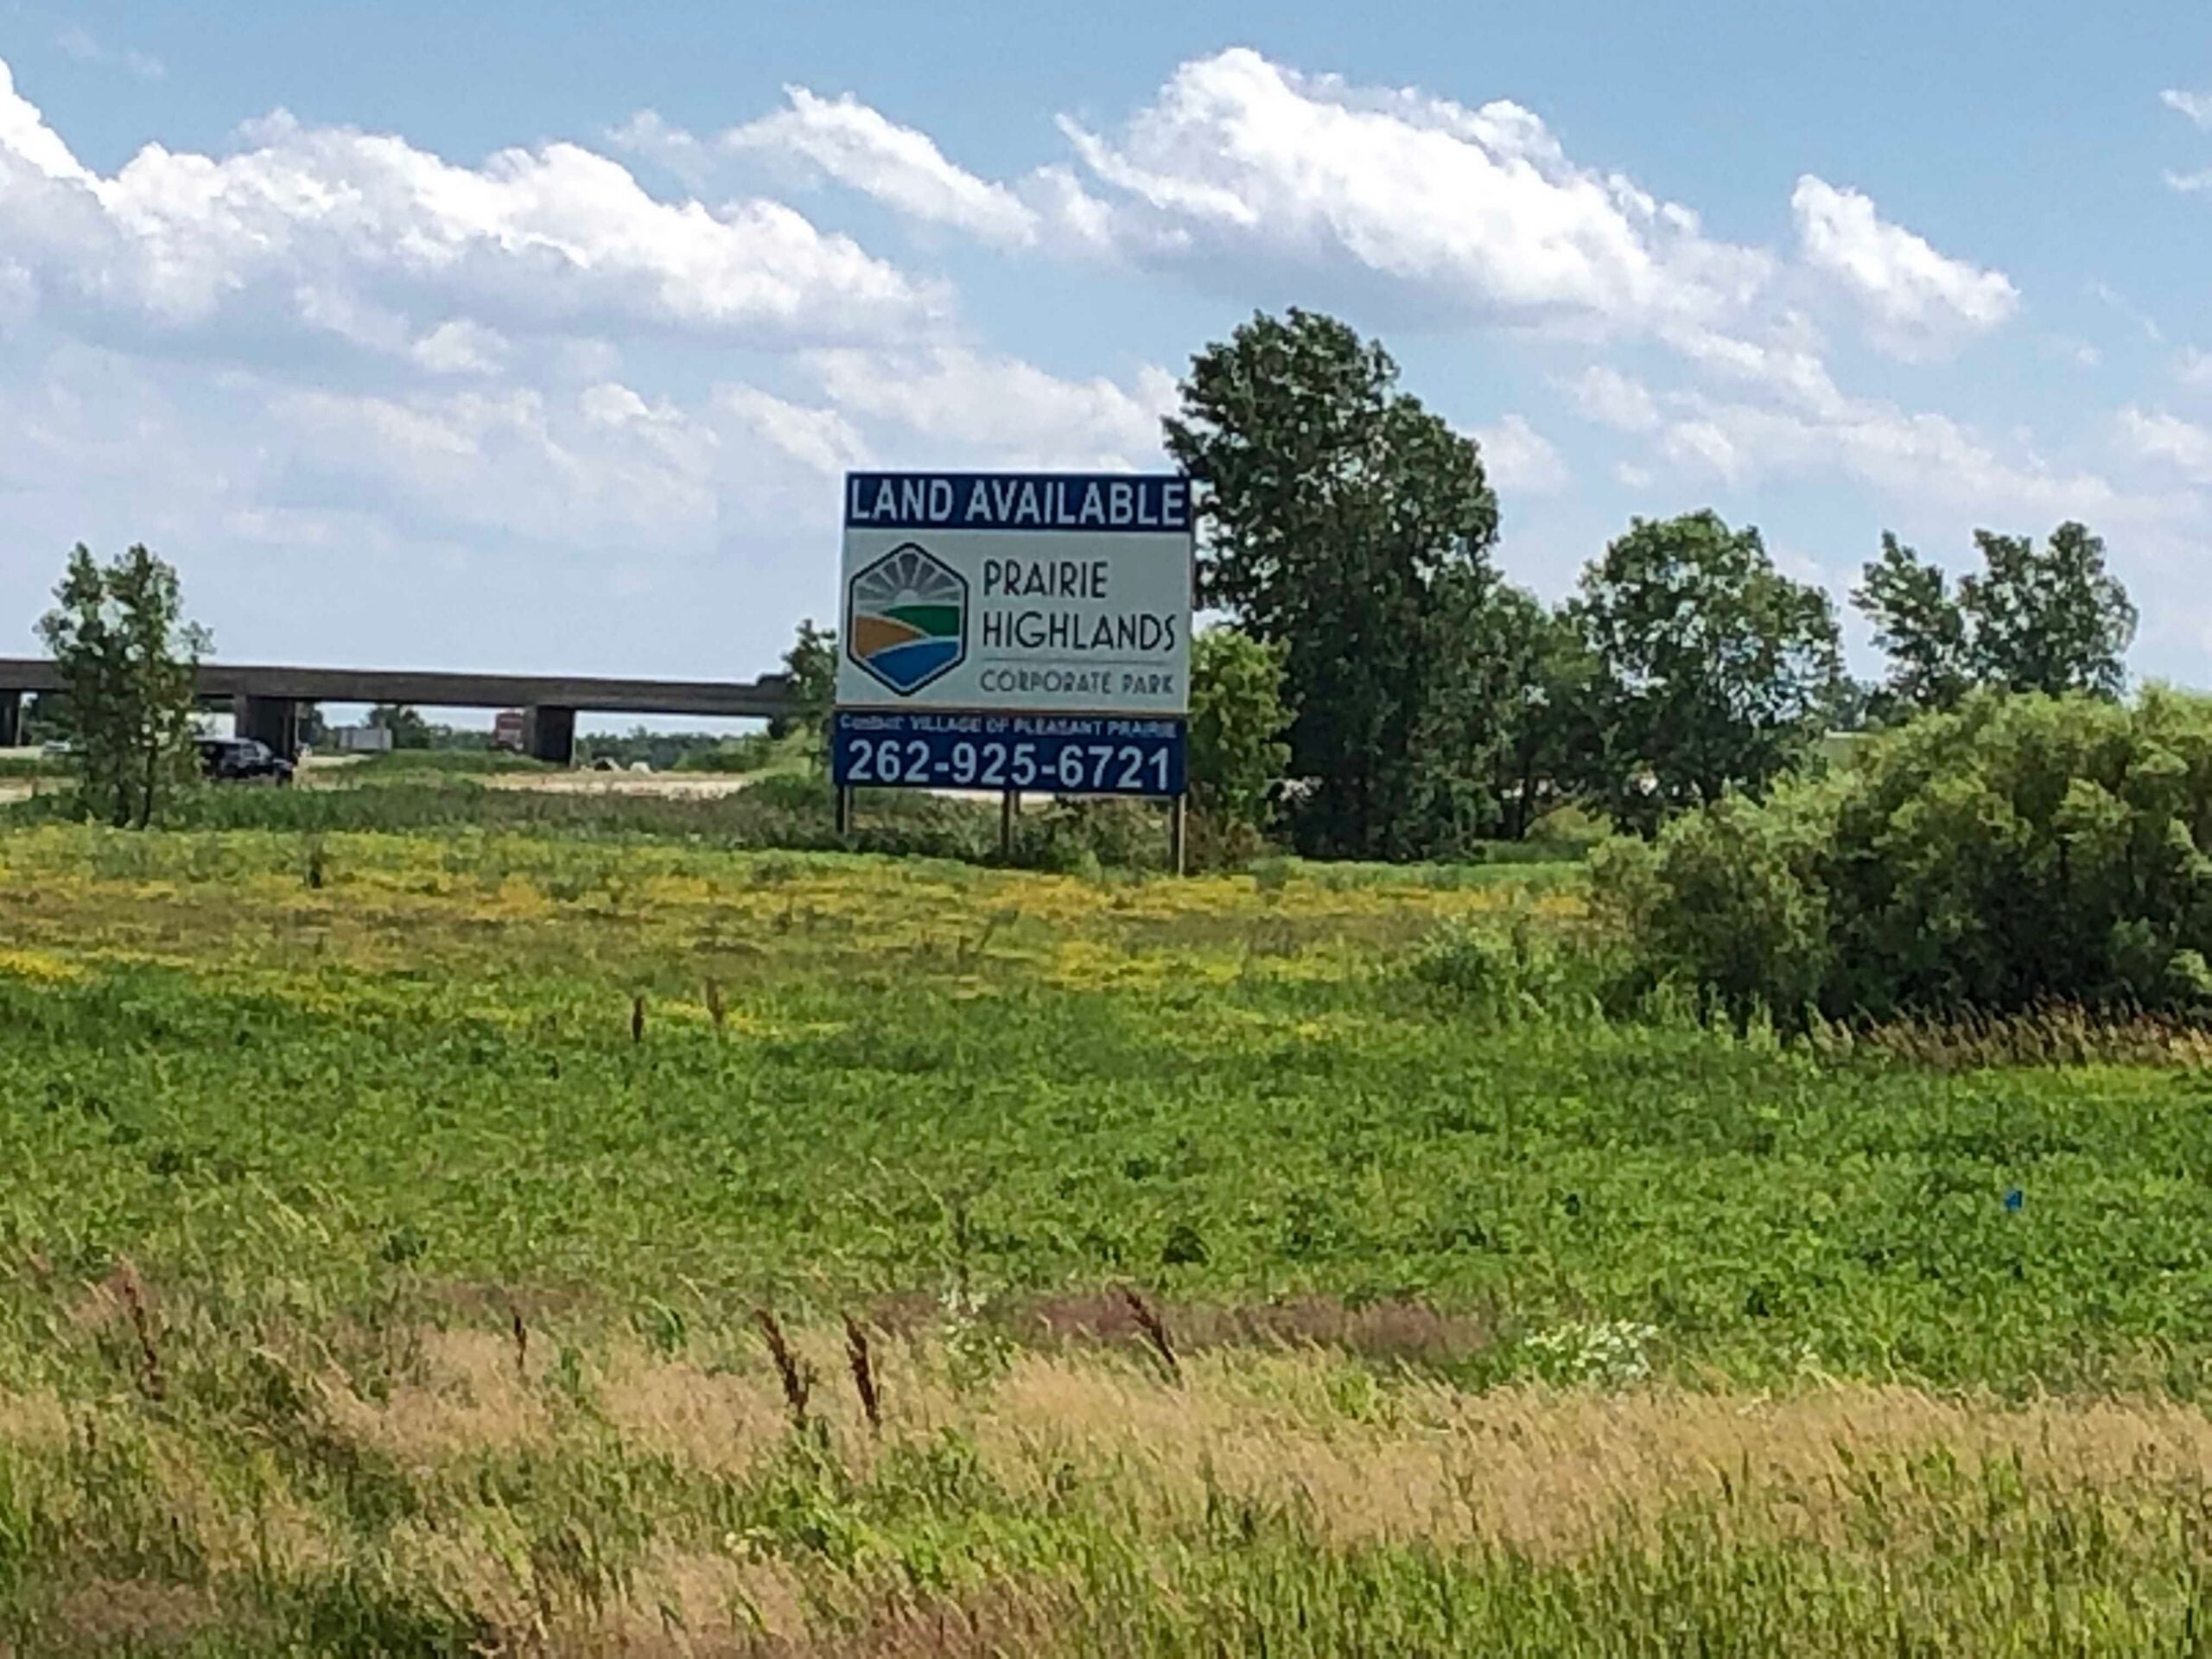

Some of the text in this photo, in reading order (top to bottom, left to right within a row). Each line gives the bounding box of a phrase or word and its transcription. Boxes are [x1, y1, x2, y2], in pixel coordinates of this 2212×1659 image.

[851, 479, 1186, 526] LAND AVAILABLE
[983, 559, 1109, 598] PRAIRIE
[982, 611, 1177, 652] HIGHLANDS
[981, 669, 1175, 695] CORPORATE PARK
[910, 715, 981, 733] VILLAGE
[986, 718, 1007, 734] OF
[1014, 719, 1103, 736] PLEASANT
[1108, 721, 1177, 739] PRAIRIE
[847, 738, 1170, 791] 262-925-6721
